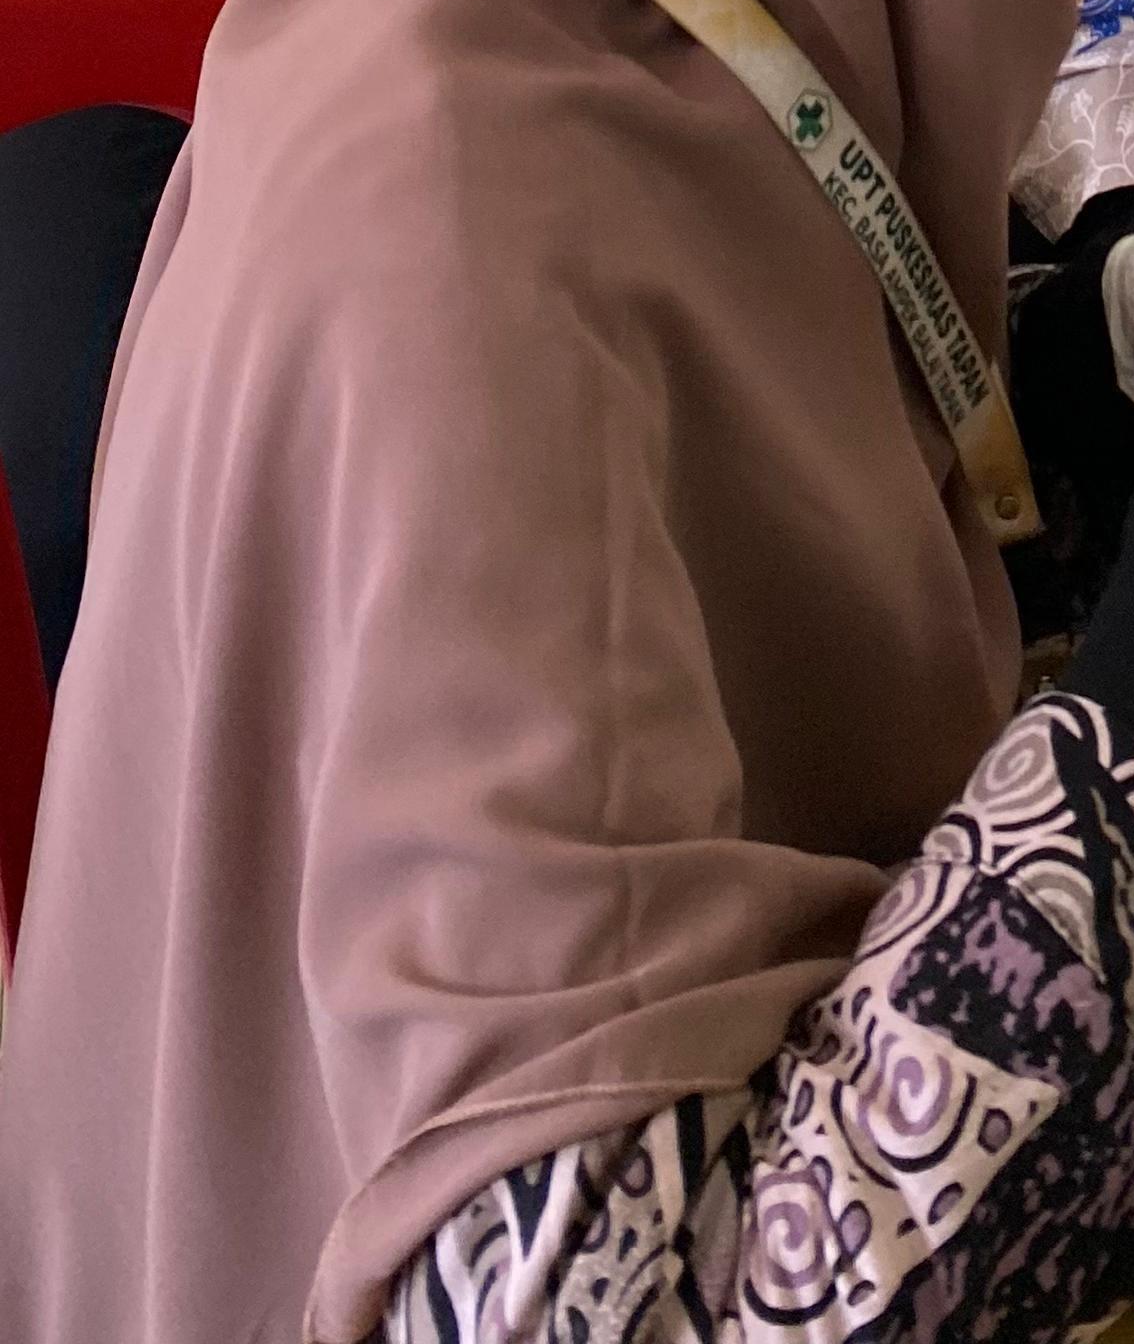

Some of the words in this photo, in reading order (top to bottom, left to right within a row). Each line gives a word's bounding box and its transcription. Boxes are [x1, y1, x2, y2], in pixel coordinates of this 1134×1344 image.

[840, 139, 886, 201] UPT
[874, 192, 958, 339] PUSKESMAS
[946, 326, 990, 408] TAPAN
